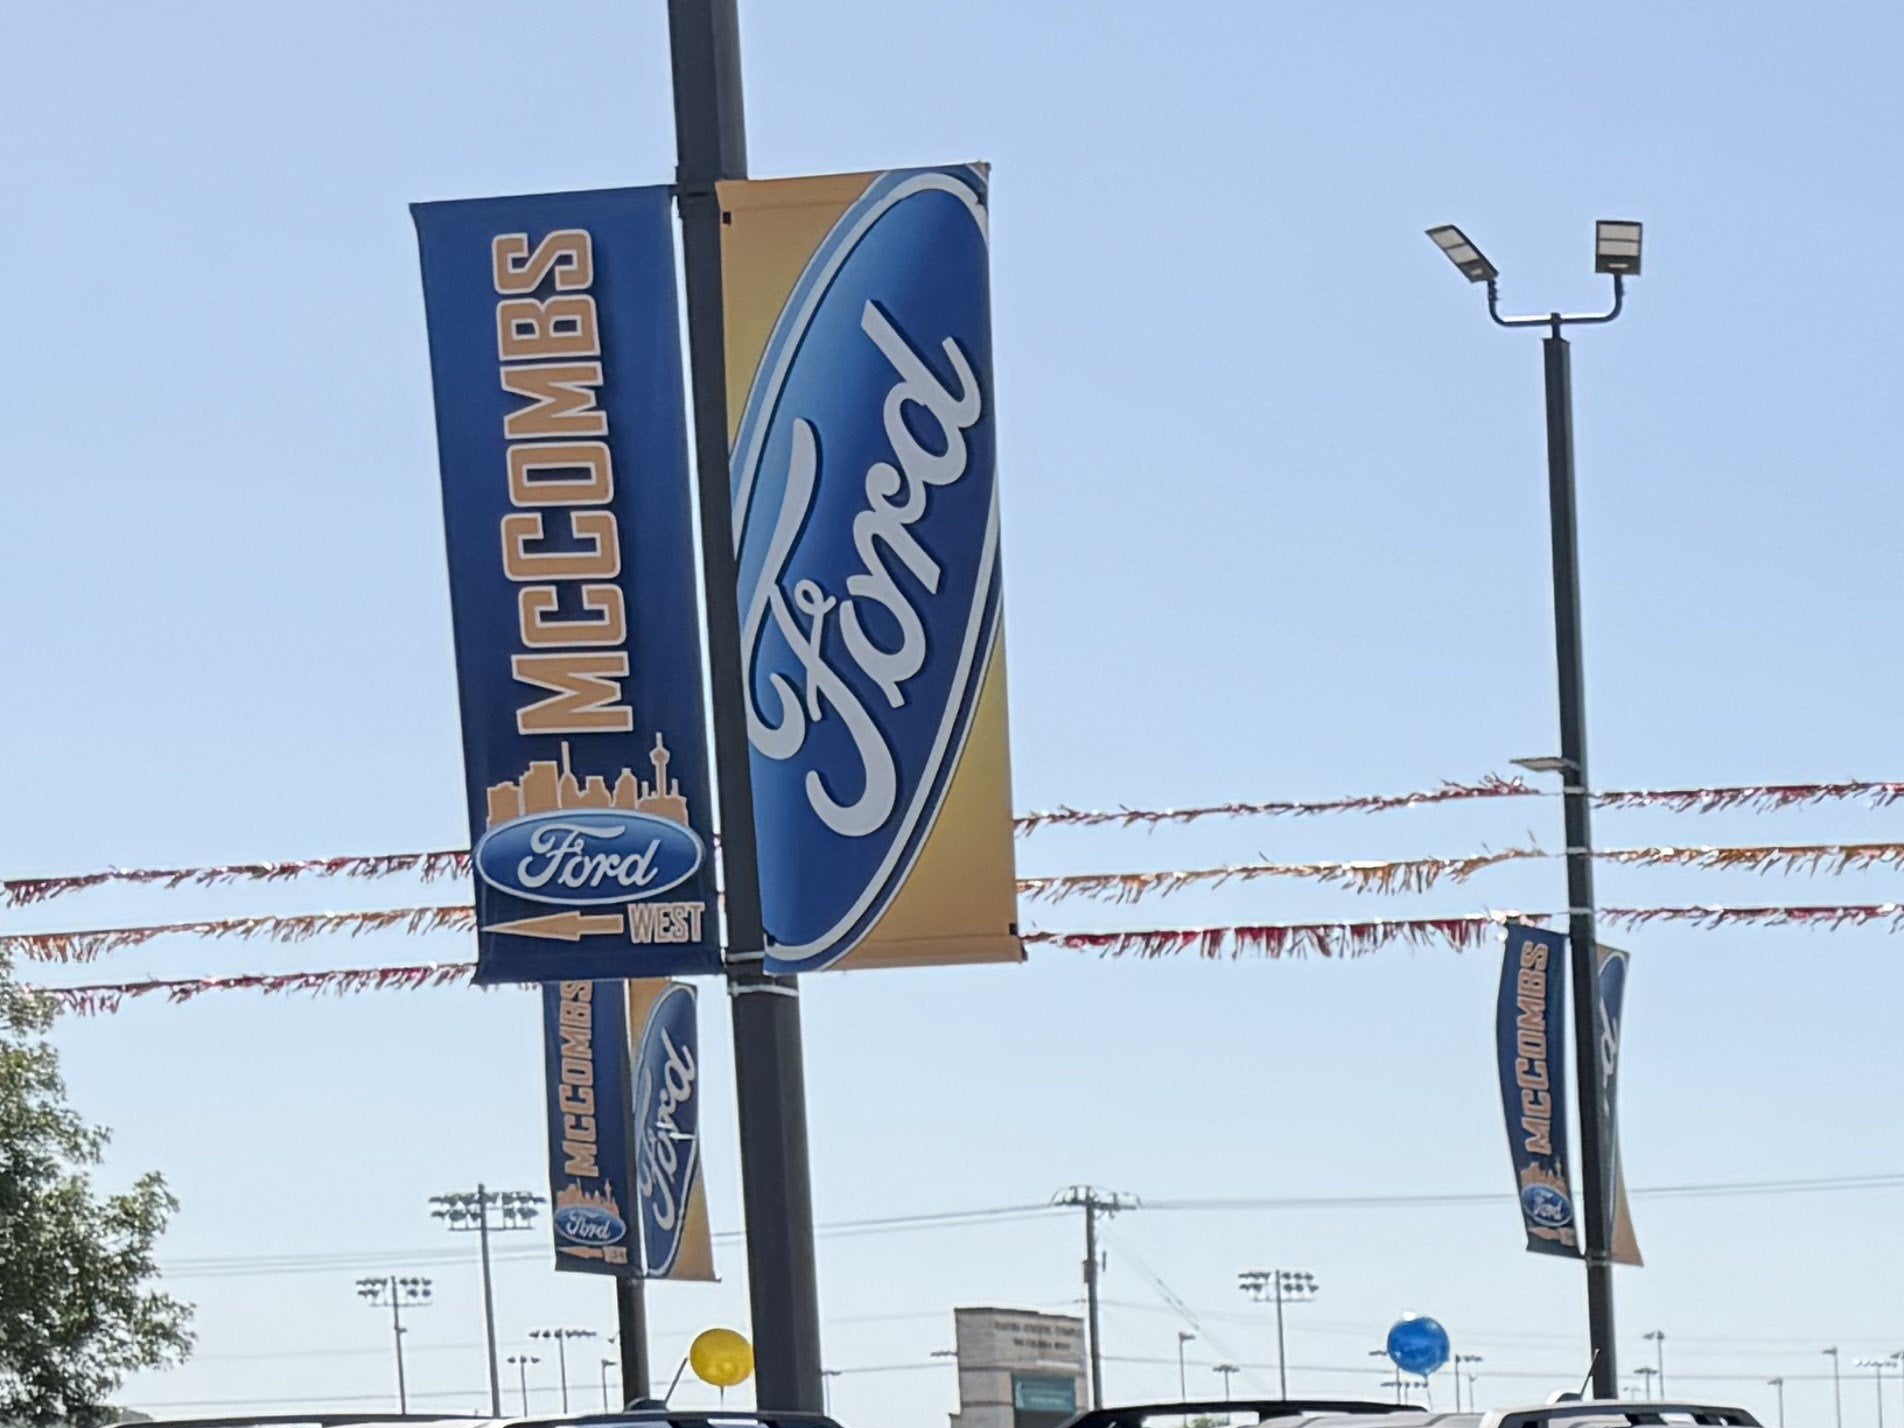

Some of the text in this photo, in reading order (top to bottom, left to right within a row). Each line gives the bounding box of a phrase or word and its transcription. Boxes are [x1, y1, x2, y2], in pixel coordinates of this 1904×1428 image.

[492, 228, 633, 735] MCCOMBS
[747, 299, 984, 837] Ford
[517, 823, 660, 889] Ford
[629, 902, 704, 944] WEST
[559, 980, 599, 1178] MCCOMBS
[635, 1027, 697, 1232] Ford
[1515, 940, 1553, 1156] MCCOMBS
[565, 1209, 611, 1240] Ford
